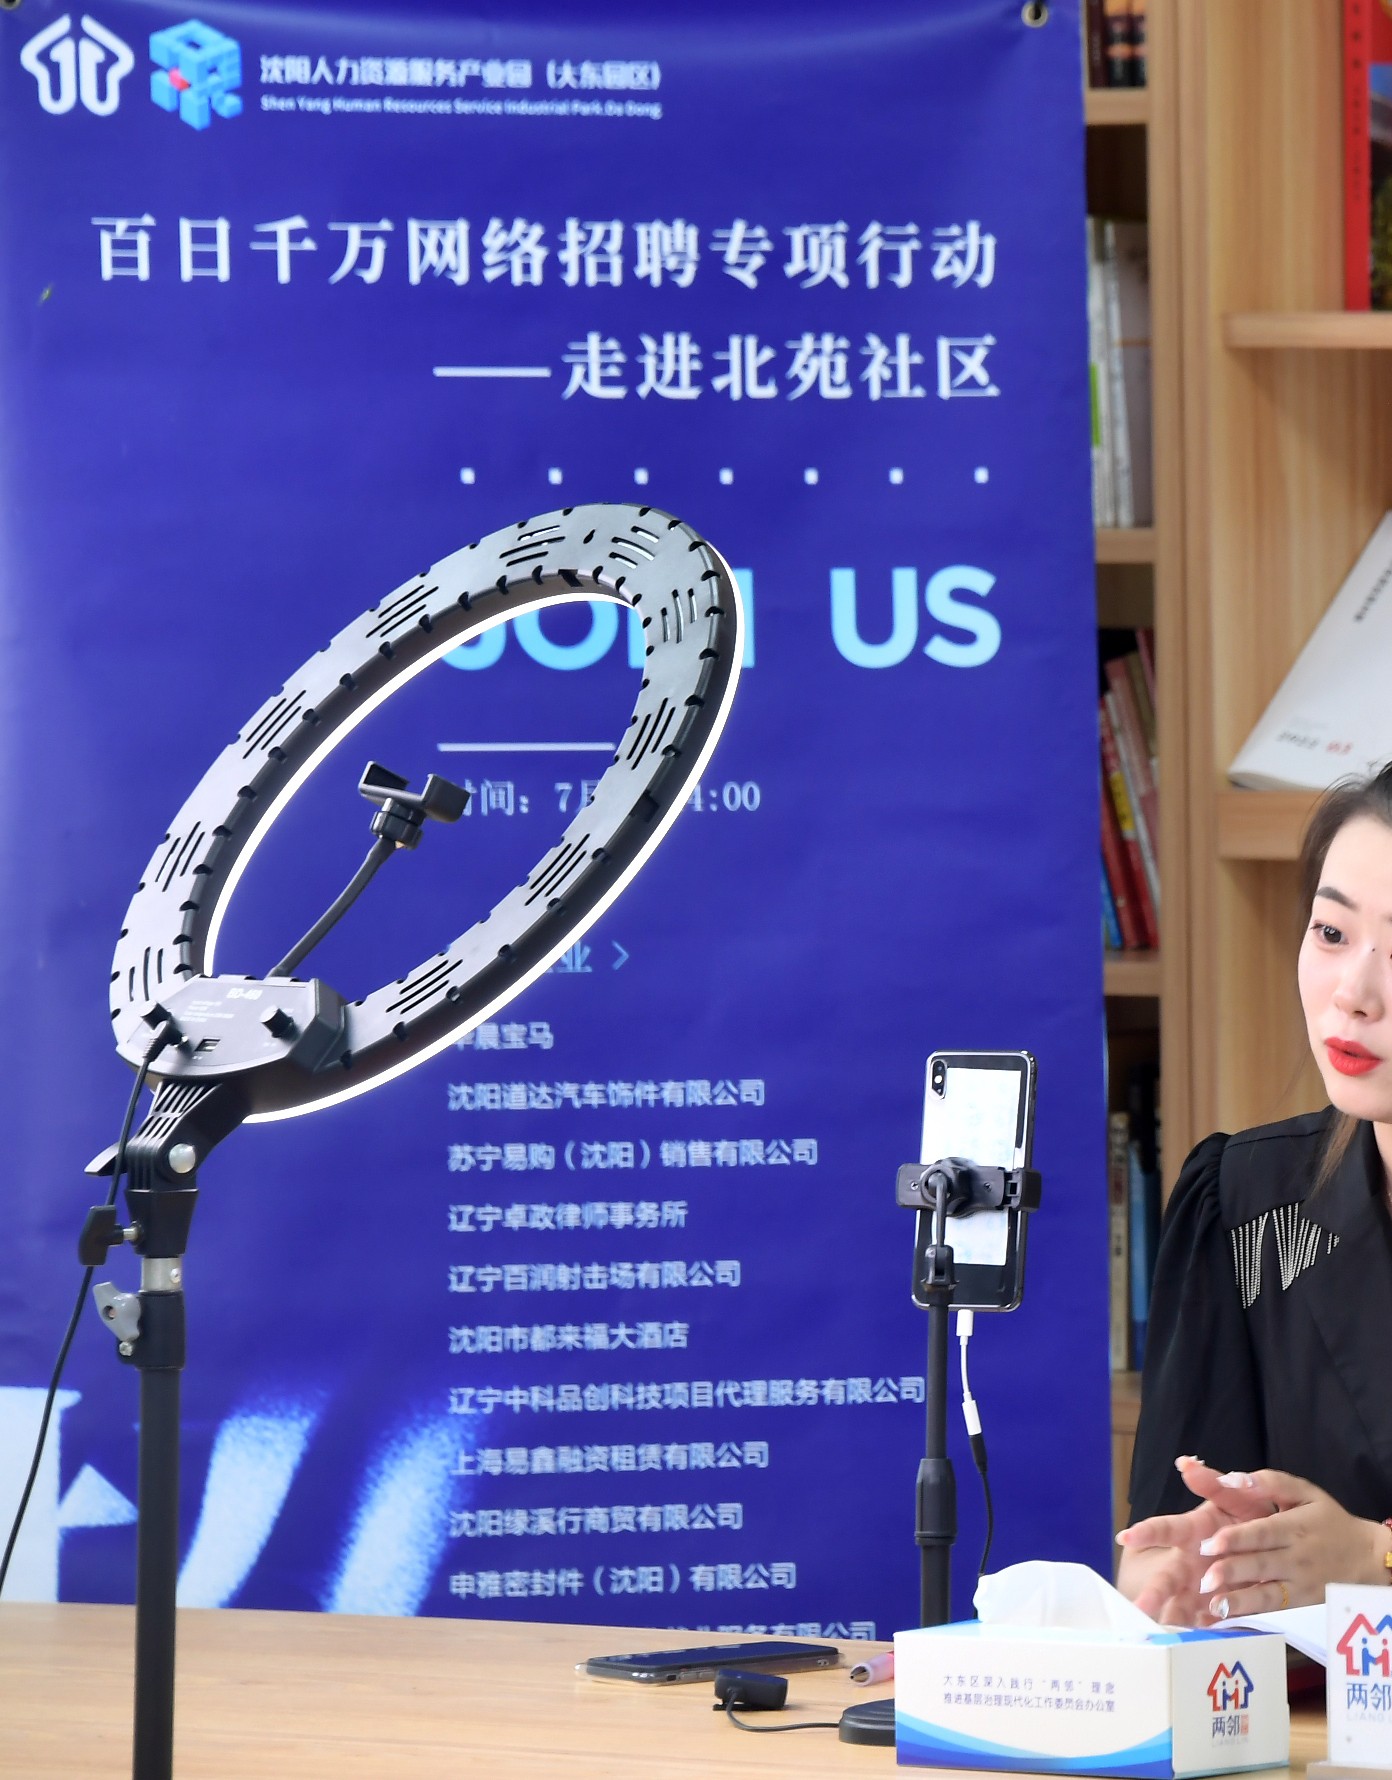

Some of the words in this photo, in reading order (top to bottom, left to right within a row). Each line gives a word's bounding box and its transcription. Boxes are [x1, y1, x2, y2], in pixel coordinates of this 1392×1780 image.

[333, 97, 382, 113] Human
[383, 97, 452, 114] Resources
[453, 98, 501, 115] Service
[91, 213, 998, 290] 百日千万网络招聘专项行动
[829, 565, 1002, 669] US
[447, 1078, 765, 1111] 沈阳道达汽车饰件有限公司
[447, 1138, 819, 1172] 苏宁易购（沈阳）销售有限公司
[447, 1200, 688, 1233] 辽宁卓政律师事务所
[447, 1259, 742, 1293] 辽宁百润射击场有限公司
[447, 1321, 690, 1354] 沈阳市都来福大酒店
[447, 1376, 926, 1416] 辽宁中科品创科技项目代理服务有限公司
[449, 1440, 770, 1477] 上海易鑫融资租赁有限公司
[449, 1502, 744, 1538] 沈阳缘溪行商贸有限公司
[449, 1561, 797, 1600] 申雅密封件（沈阳）有限公司
[1346, 1682, 1392, 1712] 两邻
[1211, 1714, 1240, 1739] 两邻
